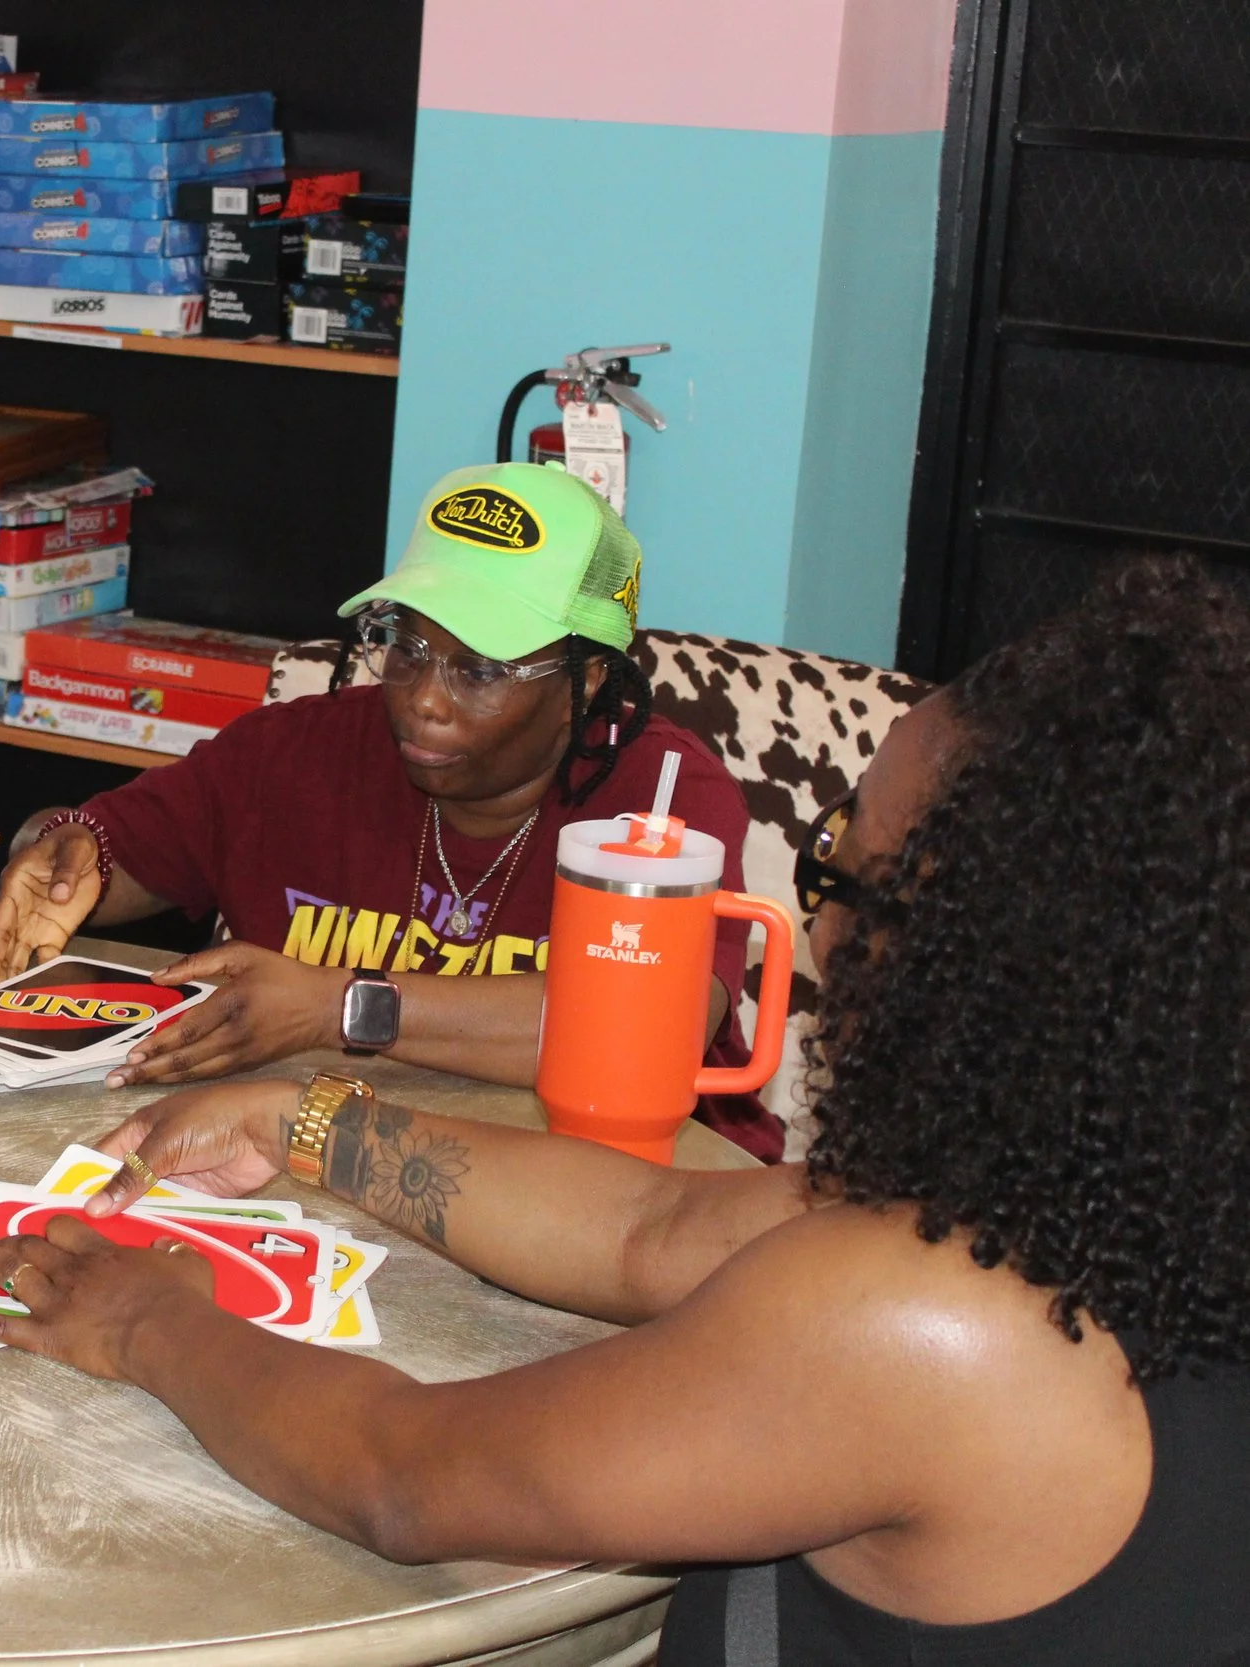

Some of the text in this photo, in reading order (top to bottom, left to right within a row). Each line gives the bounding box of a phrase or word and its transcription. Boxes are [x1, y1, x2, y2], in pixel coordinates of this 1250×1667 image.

[208, 229, 236, 241] Cards
[208, 240, 242, 253] Against
[209, 288, 237, 300] Cards
[209, 299, 244, 312] Against
[208, 310, 252, 324] Humanity
[442, 496, 524, 537] Von Dutch
[132, 655, 194, 677] SCRABBLE
[28, 669, 126, 701] Backgammon
[60, 708, 99, 725] CANDY
[414, 882, 490, 940] THE
[586, 943, 659, 965] STANLEY
